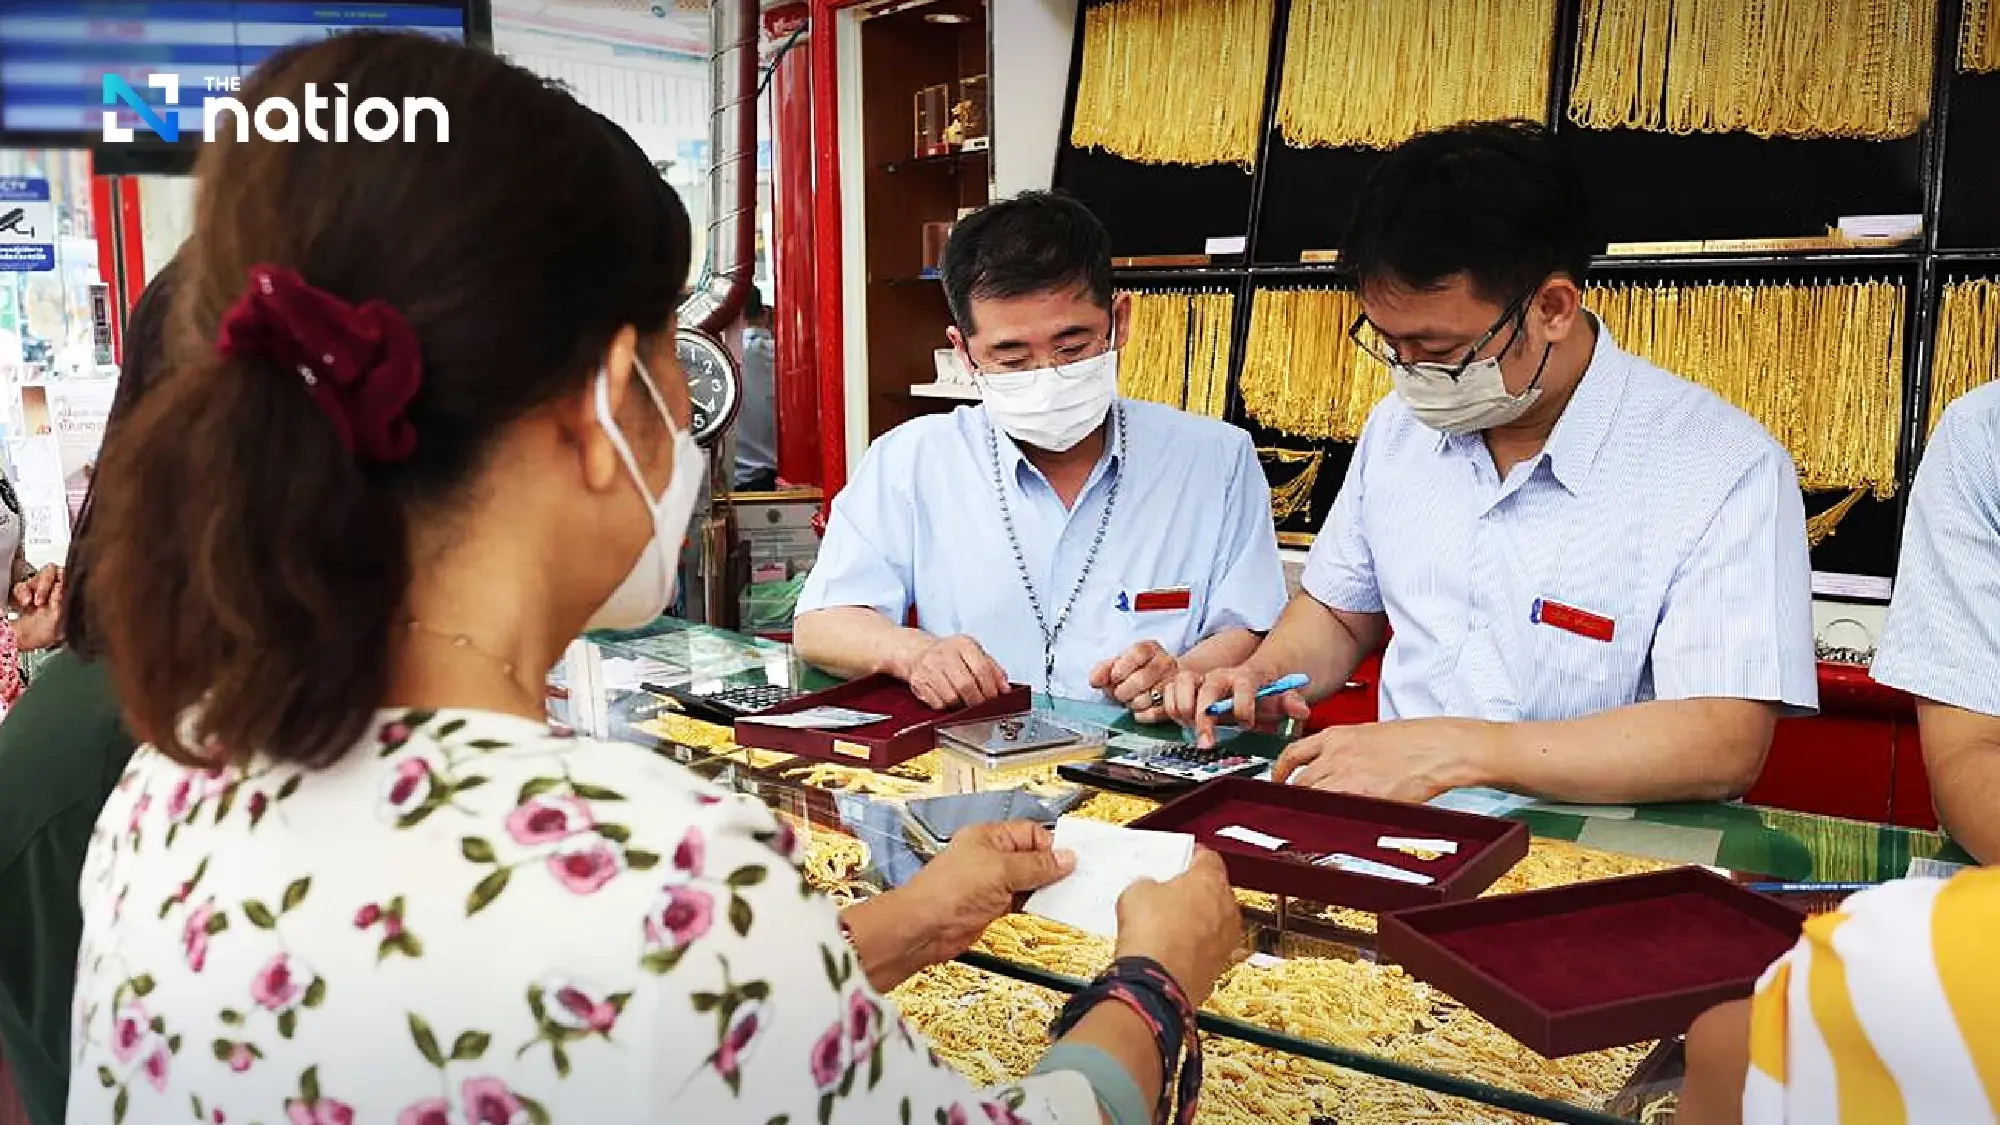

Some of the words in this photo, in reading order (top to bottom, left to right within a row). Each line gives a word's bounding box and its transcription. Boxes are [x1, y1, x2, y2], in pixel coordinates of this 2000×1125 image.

[703, 360, 713, 375] 2
[711, 379, 722, 392] 3
[693, 414, 705, 429] 5
